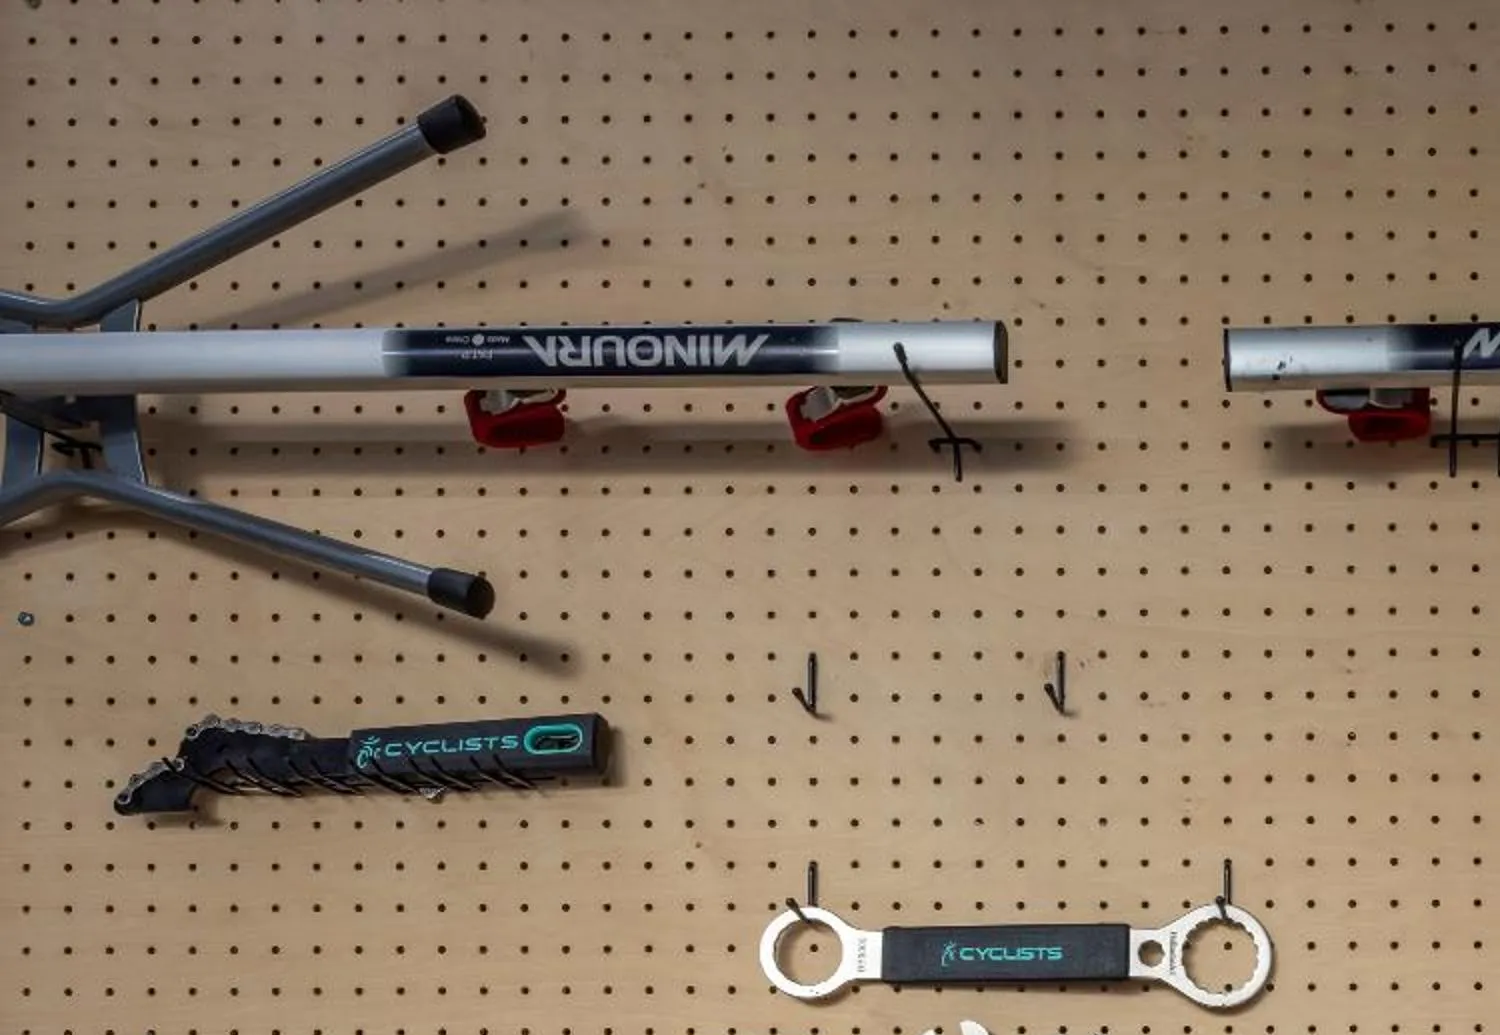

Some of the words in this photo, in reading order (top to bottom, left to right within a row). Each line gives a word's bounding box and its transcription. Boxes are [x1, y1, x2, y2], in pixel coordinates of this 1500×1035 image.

[521, 333, 771, 368] MINOURA
[384, 734, 520, 757] CYCLISTS
[959, 945, 1064, 963] CYCLISTS
